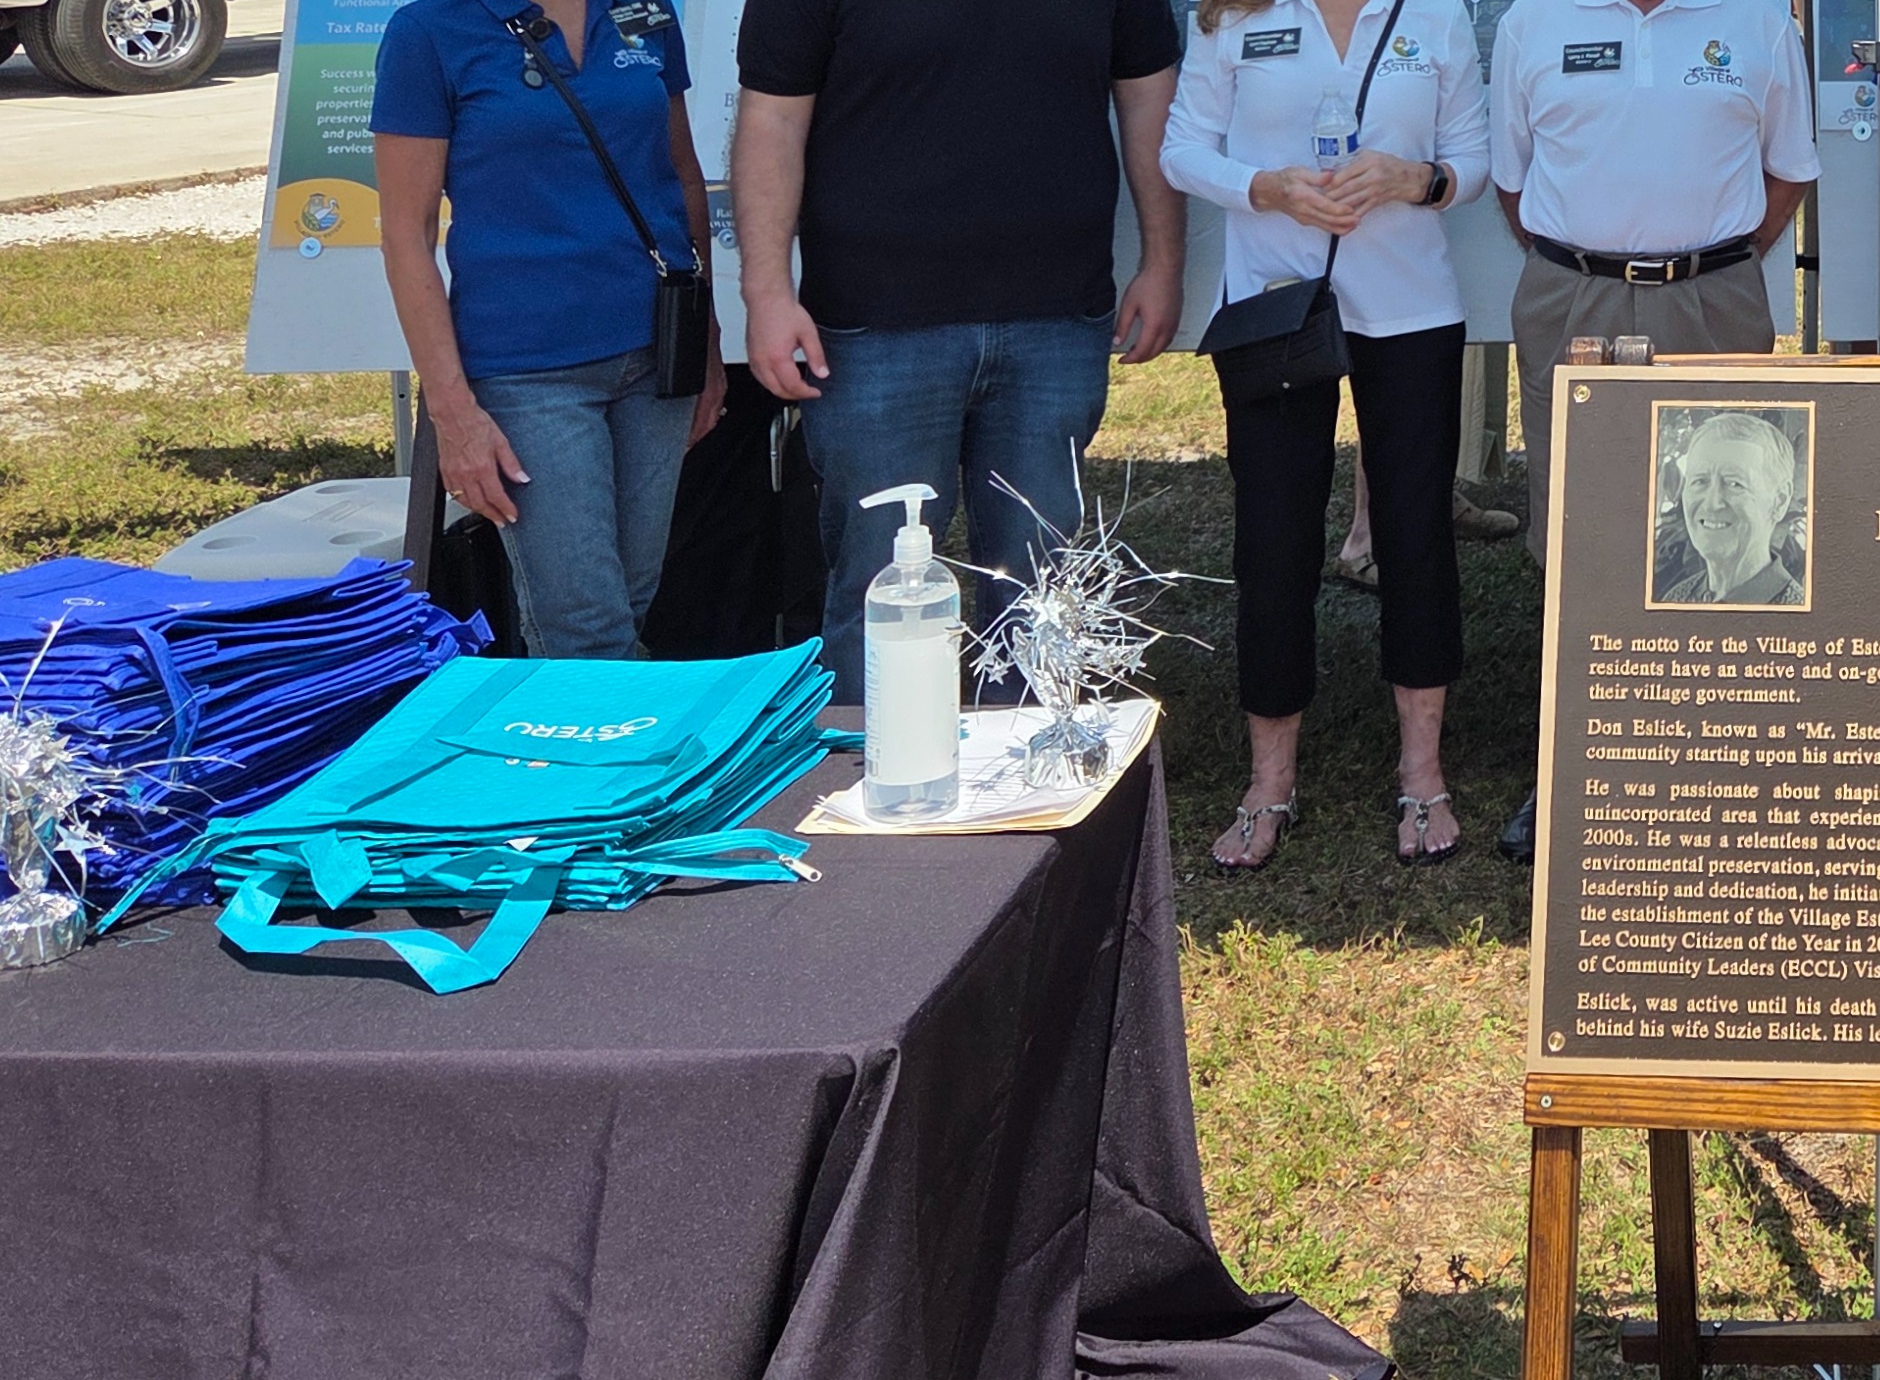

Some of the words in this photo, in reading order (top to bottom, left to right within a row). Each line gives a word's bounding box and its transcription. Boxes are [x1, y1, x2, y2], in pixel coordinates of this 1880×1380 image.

[326, 22, 352, 34] Tax
[320, 69, 364, 79] Success
[333, 84, 375, 94] securin
[321, 129, 345, 139] and
[1589, 633, 1623, 652] The
[1630, 636, 1680, 654] motto
[1687, 634, 1714, 654] for
[1721, 635, 1749, 655] the
[1755, 635, 1818, 659] Village
[1824, 636, 1845, 656] of
[1588, 658, 1665, 678] residents
[1670, 659, 1712, 678] have
[1717, 663, 1738, 679] an
[1743, 659, 1795, 680] active
[1801, 660, 1833, 680] and
[1588, 682, 1629, 701] their
[1633, 683, 1691, 706] village
[1695, 687, 1801, 707] government.
[1587, 718, 1623, 736] Don
[1632, 717, 1692, 740] Eslick,
[1701, 718, 1758, 739] known
[1767, 723, 1786, 740] as
[1576, 991, 1637, 1015] Eslick,
[1645, 996, 1678, 1013] was
[1686, 994, 1739, 1014] active
[1747, 995, 1788, 1015] until
[1795, 995, 1822, 1016] his
[1829, 995, 1877, 1017] death
[1576, 1017, 1635, 1038] behind
[1639, 1018, 1665, 1038] his
[1671, 1018, 1710, 1040] wife
[1714, 1019, 1763, 1041] Suzie
[1767, 1020, 1828, 1042] Eslick.
[1833, 1022, 1863, 1043] His
